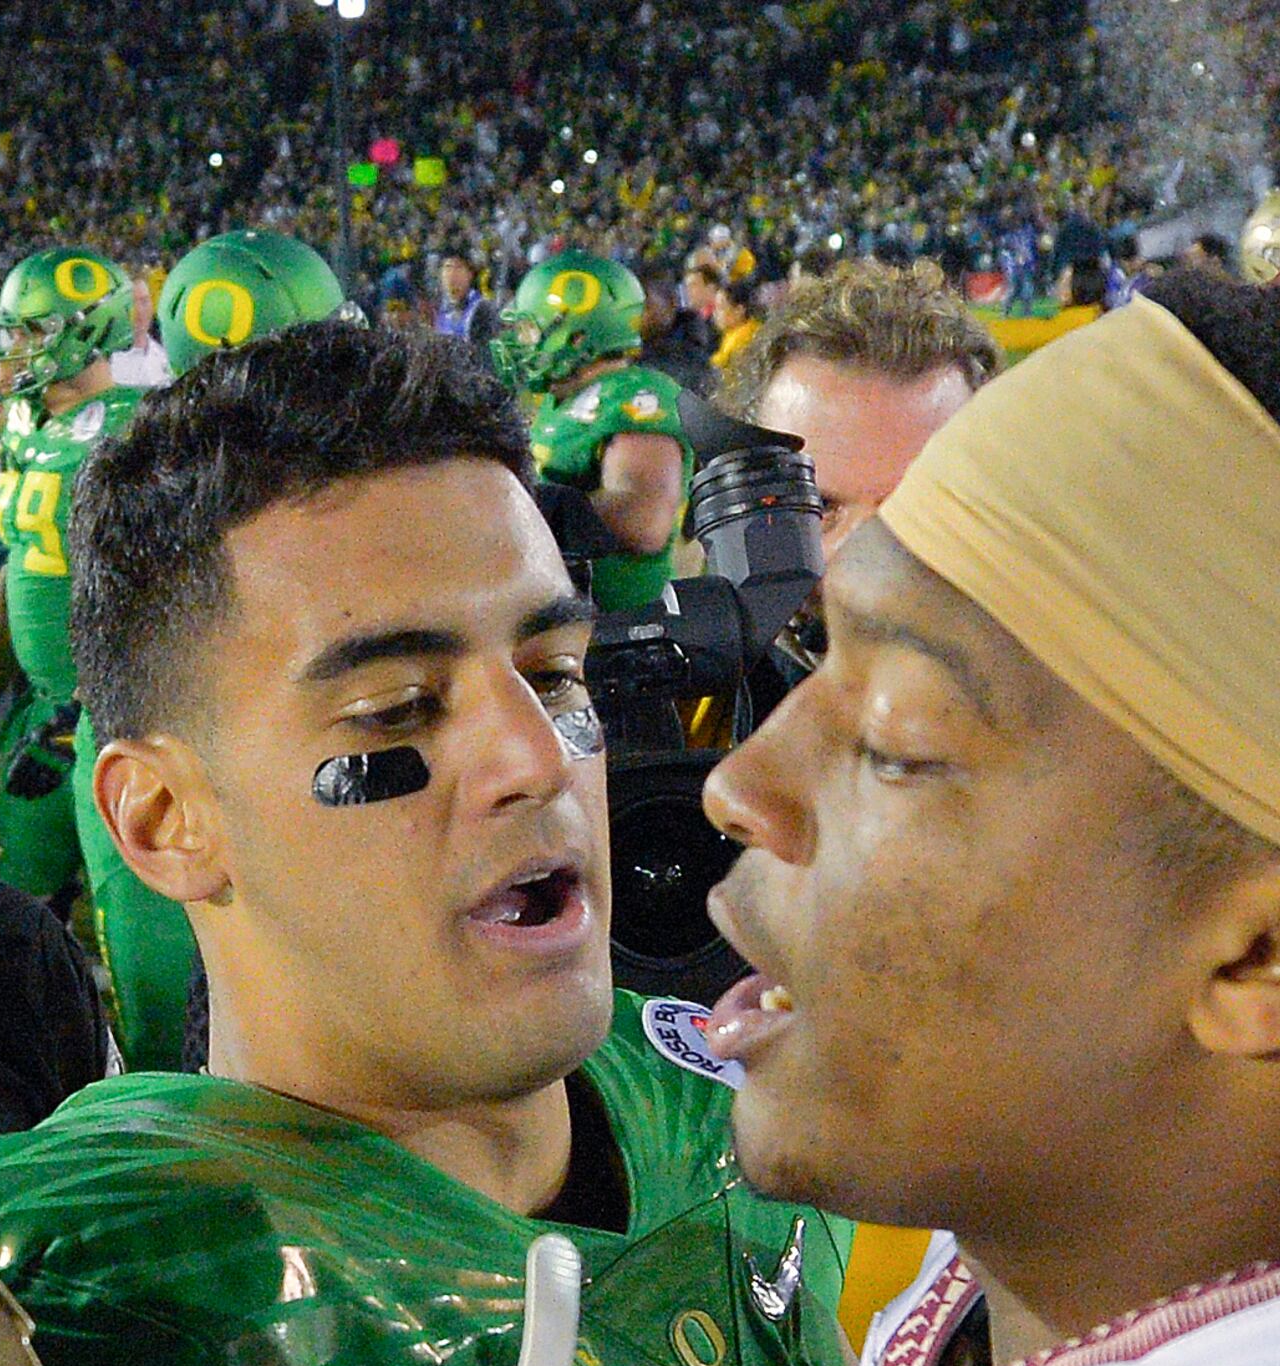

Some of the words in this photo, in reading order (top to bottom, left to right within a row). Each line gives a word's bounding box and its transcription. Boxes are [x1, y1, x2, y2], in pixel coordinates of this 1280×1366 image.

[54, 257, 111, 301] O
[184, 278, 255, 348] O
[655, 1026, 725, 1075] ROSE
